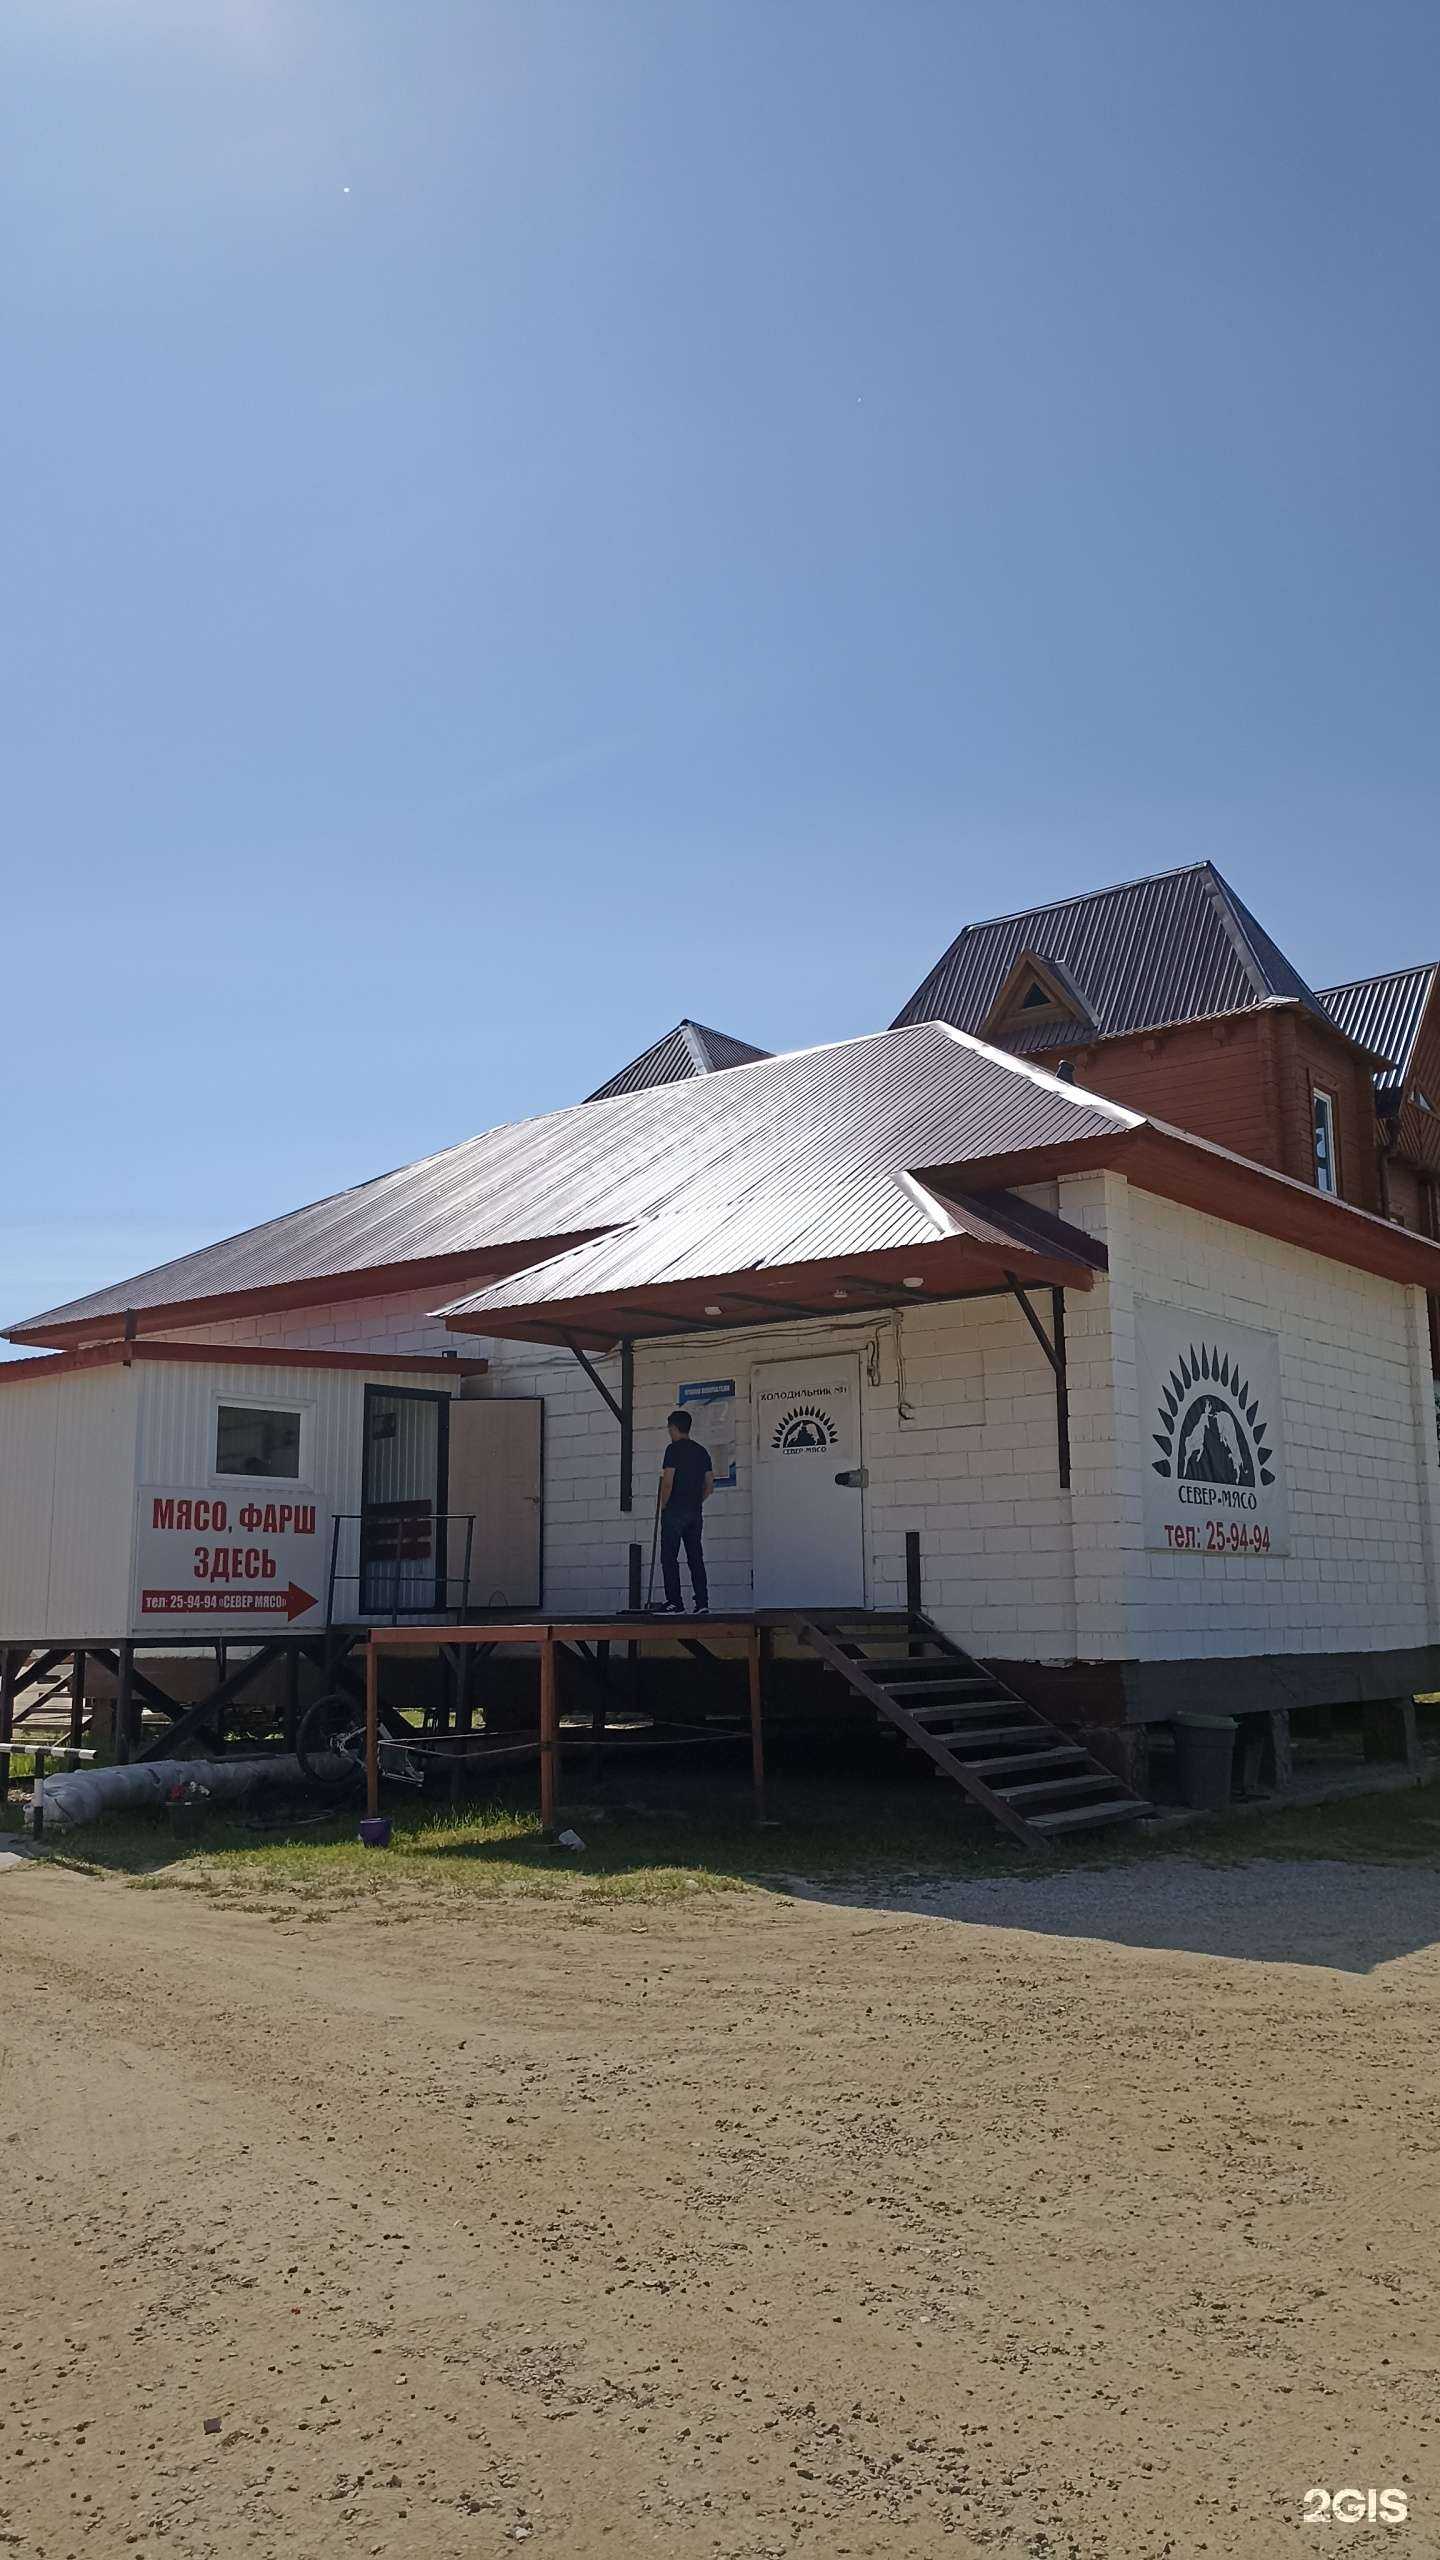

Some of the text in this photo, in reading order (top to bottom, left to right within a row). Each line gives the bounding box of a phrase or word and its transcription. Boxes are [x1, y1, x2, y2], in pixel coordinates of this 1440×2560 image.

[761, 1387, 831, 1401] ХОЛОДИЛЬНИК
[152, 1499, 316, 1534] МЯСО, ФАРШ
[1164, 1520, 1270, 1552] тел: 25-94-94
[193, 1547, 276, 1583] ЗДЕСЬ
[170, 1595, 217, 1608] 25-94-94
